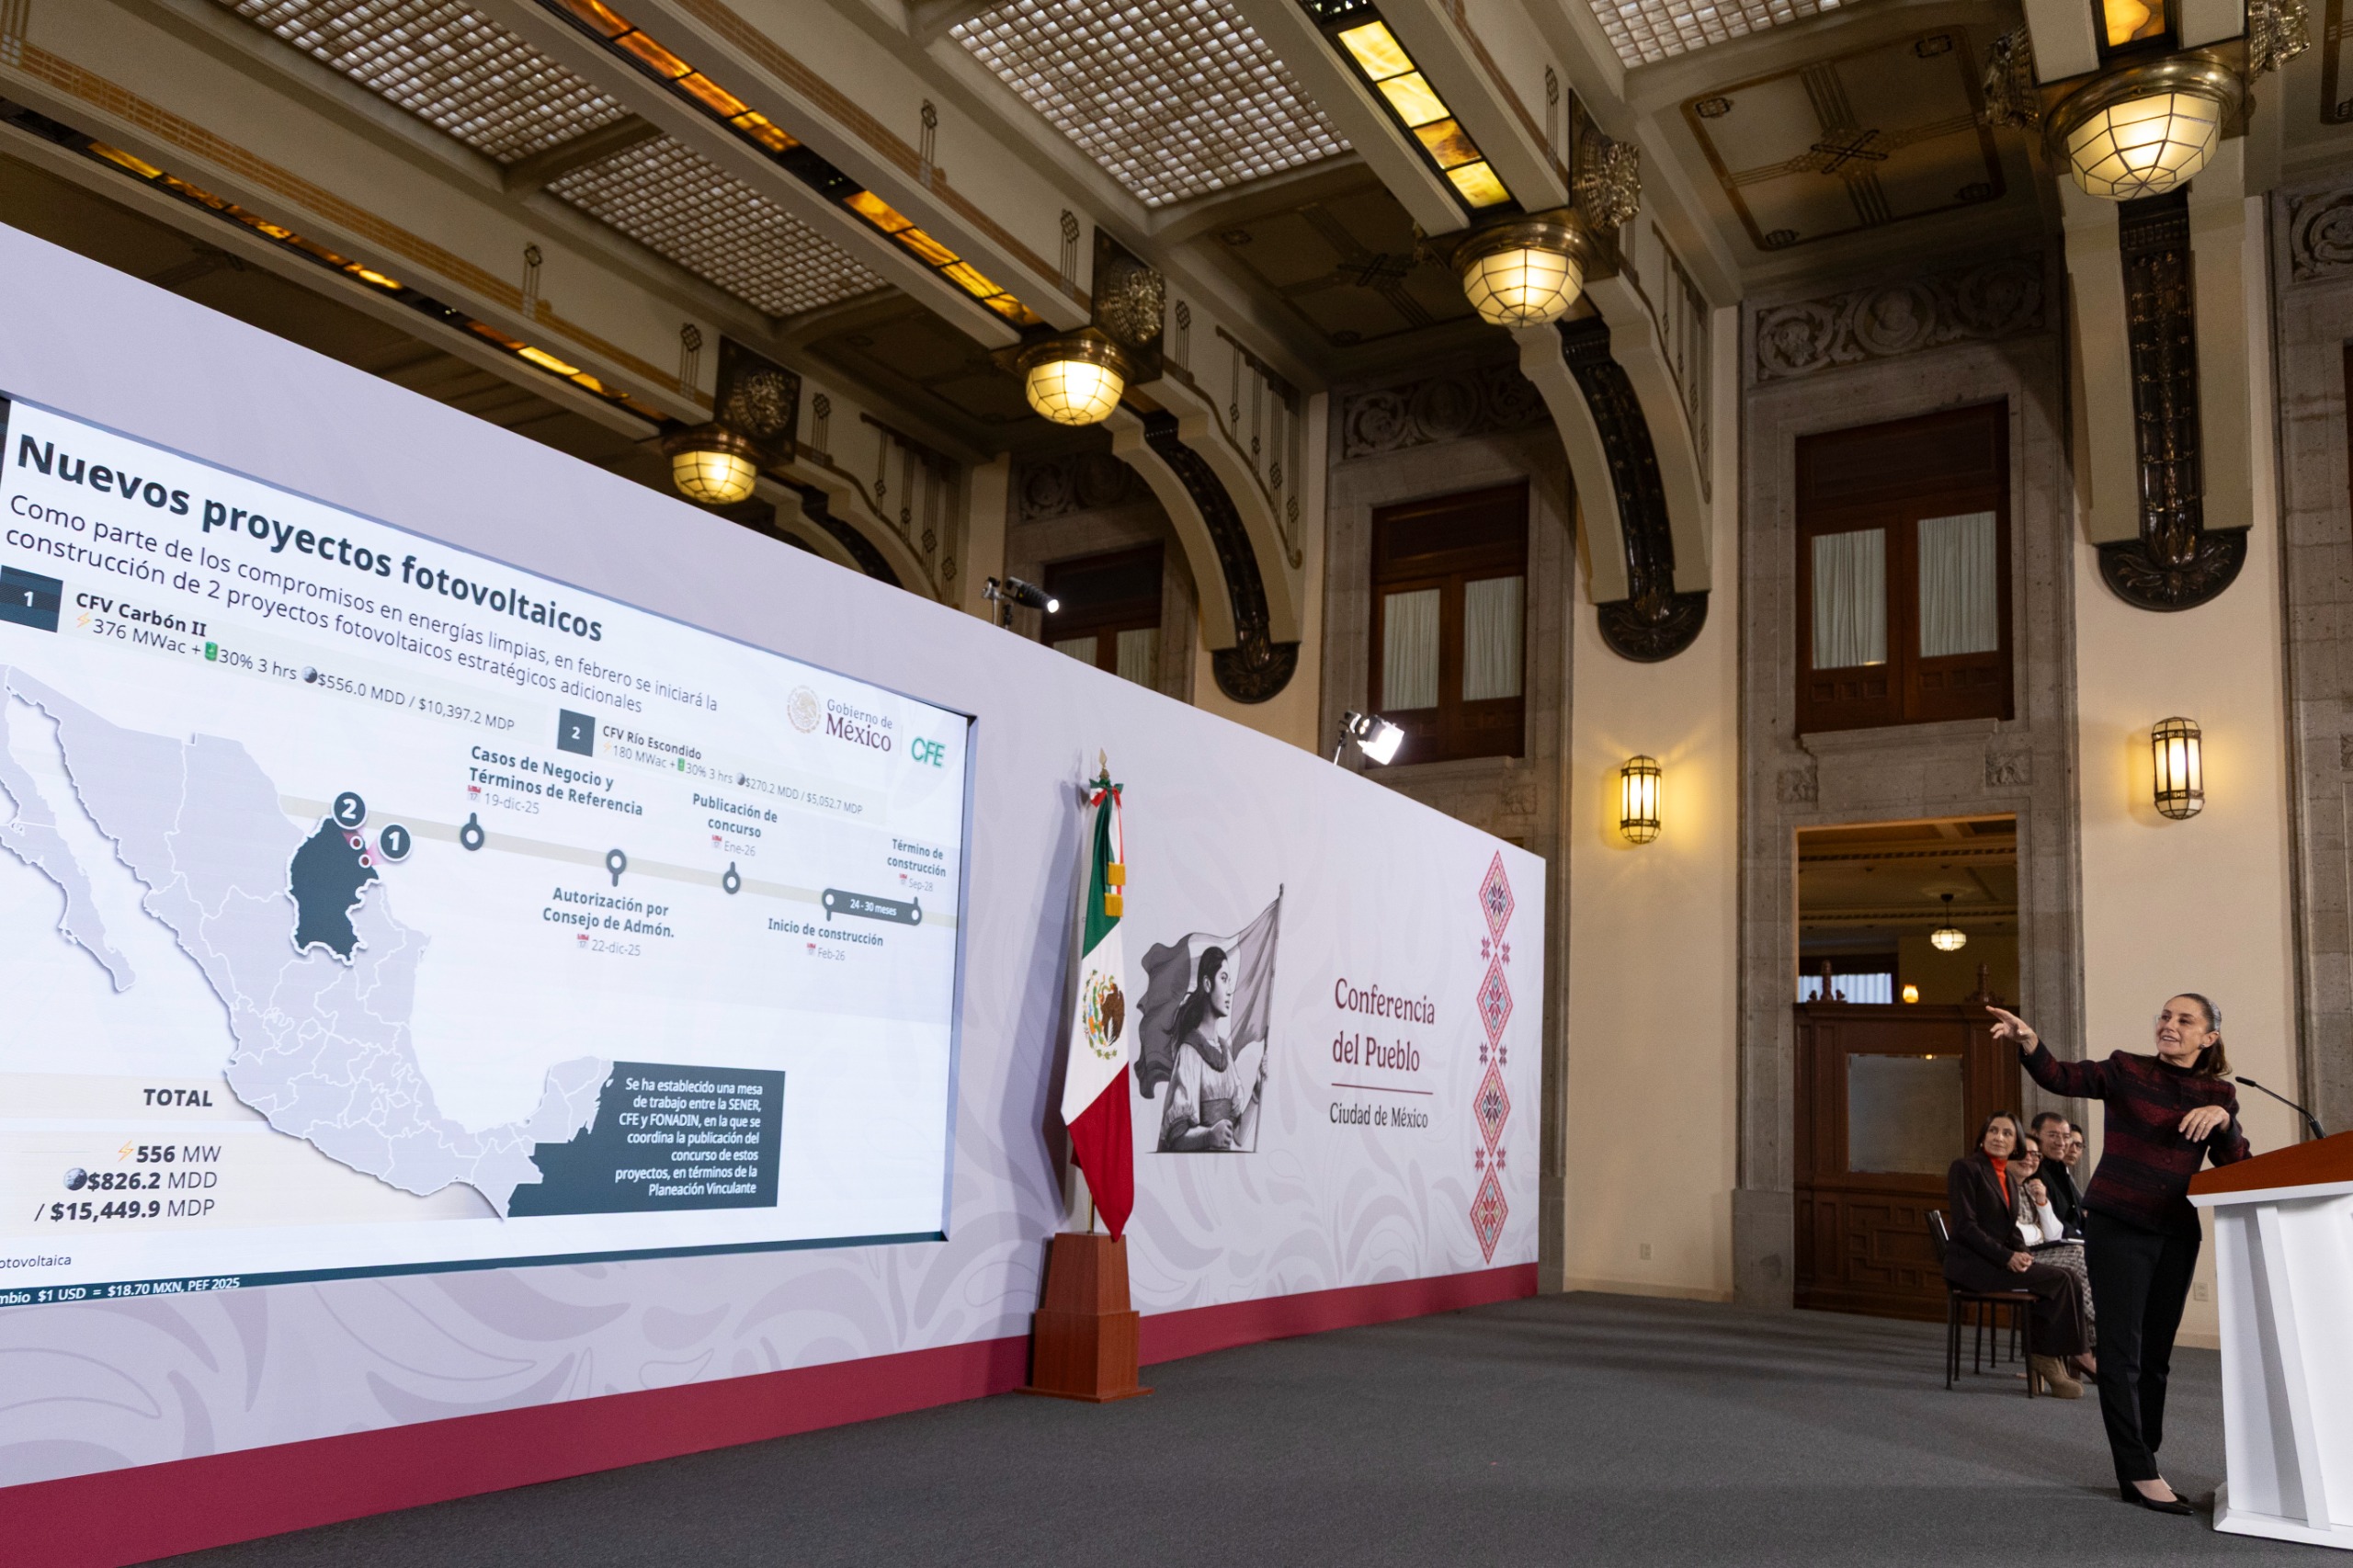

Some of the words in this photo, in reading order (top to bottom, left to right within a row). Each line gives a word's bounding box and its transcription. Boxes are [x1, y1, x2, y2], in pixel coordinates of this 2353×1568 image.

[17, 433, 190, 516] Nuevos
[202, 498, 392, 578] proyectos
[403, 555, 603, 642] fotovoltaicos
[11, 494, 85, 531] Como
[94, 519, 157, 552] parte
[165, 539, 193, 562] de
[200, 547, 231, 574] los
[238, 563, 375, 614] compromisos
[381, 604, 403, 621] en
[409, 614, 483, 645] energías
[489, 631, 550, 665] limpias,
[555, 653, 573, 670] en
[578, 658, 632, 687] febrero
[637, 676, 652, 692] se
[655, 676, 702, 708] iniciará
[707, 695, 718, 711] la
[24, 591, 33, 607] 1
[6, 528, 165, 585] construcción
[174, 571, 200, 594] de
[208, 581, 220, 598] 2
[228, 588, 329, 629] proyectos
[335, 614, 452, 662] fotovoltaicos
[458, 653, 556, 690] estratégicos
[561, 679, 642, 713] adicionales
[76, 593, 112, 614] CFV
[119, 603, 187, 632] Carbón
[191, 622, 206, 637] II
[93, 619, 127, 640] 376
[133, 629, 187, 654] MWac
[219, 650, 253, 670] 30%
[258, 658, 267, 673] 3
[273, 661, 297, 680] hrs
[318, 673, 367, 698] $556.0
[370, 686, 405, 706] MDD
[419, 697, 482, 725] $10,397.2
[485, 713, 515, 731] MDP
[827, 699, 878, 724] Gobierno
[881, 716, 892, 729] de
[572, 726, 580, 740] 2
[603, 725, 624, 741] CFV
[628, 733, 645, 745] Río
[648, 737, 701, 761] Escondido
[826, 712, 892, 752] México
[911, 737, 946, 767] CFE
[472, 745, 517, 770] Casos
[520, 756, 539, 773] de
[543, 761, 602, 788] Negocio
[606, 778, 614, 791] y
[614, 745, 632, 759] 180
[635, 752, 666, 768] MWac
[686, 763, 706, 778] 30%
[710, 768, 715, 779] 3
[719, 770, 733, 784] hrs
[745, 778, 775, 794] $270.2
[778, 785, 799, 800] MDD
[807, 792, 842, 811] $5,052.7
[844, 802, 863, 815] MDP
[470, 767, 542, 796] Términos
[546, 784, 564, 801] de
[568, 788, 643, 816] Referencia
[342, 798, 357, 820] 2
[484, 792, 540, 815] 19-dic-25
[693, 793, 762, 820] Publicación
[765, 805, 778, 823] de
[708, 817, 761, 838] concurso
[389, 831, 400, 851] 1
[724, 841, 756, 857] Ene-26
[892, 838, 930, 858] Término
[932, 846, 943, 860] de
[887, 856, 946, 878] construcción
[908, 879, 933, 892] Sep-28
[552, 887, 643, 915] Autorización
[647, 901, 669, 917] por
[849, 898, 859, 909] 24
[864, 901, 874, 912] 30
[874, 904, 897, 916] meses
[543, 907, 600, 930] Consejo
[604, 916, 620, 930] de
[623, 920, 675, 938] Admón.
[767, 918, 800, 937] Inicio
[802, 925, 815, 937] de
[818, 925, 883, 947] construcción
[591, 938, 641, 957] 22-dic-25
[818, 947, 845, 960] Feb-26
[1335, 978, 1435, 1026] Conferencia
[1332, 1031, 1359, 1065] del
[1366, 1037, 1420, 1072] Pueblo
[143, 1088, 213, 1107] TOTAL
[626, 1078, 640, 1090] Se
[642, 1078, 655, 1091] ha
[657, 1079, 715, 1093] establecido
[717, 1083, 735, 1094] una
[737, 1084, 763, 1096] mesa
[633, 1096, 647, 1108] de
[650, 1096, 687, 1111] trabajo
[689, 1097, 715, 1109] entre
[718, 1098, 726, 1109] la
[728, 1098, 761, 1112] SENER,
[620, 1113, 639, 1125] CFE
[641, 1116, 648, 1129] y
[650, 1114, 701, 1129] FONADIN,
[704, 1118, 717, 1127] en
[719, 1115, 727, 1127] la
[730, 1119, 747, 1130] que
[750, 1119, 761, 1128] se
[1330, 1103, 1370, 1126] Ciudad
[1374, 1105, 1389, 1126] de
[1392, 1107, 1428, 1129] México
[627, 1131, 674, 1143] coordina
[676, 1131, 685, 1143] la
[688, 1131, 743, 1146] publicación
[745, 1132, 759, 1143] del
[136, 1145, 176, 1163] 556
[183, 1145, 222, 1163] MW
[671, 1151, 717, 1161] concurso
[719, 1149, 732, 1160] de
[733, 1151, 758, 1161] estos
[87, 1172, 160, 1192] $826.2
[167, 1171, 218, 1189] MDD
[615, 1168, 670, 1183] proyectos,
[673, 1169, 686, 1178] en
[688, 1165, 733, 1178] términos
[734, 1165, 746, 1177] de
[749, 1165, 757, 1177] la
[649, 1183, 704, 1196] Planeación
[706, 1182, 756, 1194] Vinculante
[51, 1200, 160, 1222] $15,449.9
[167, 1199, 215, 1217] MDP
[38, 1290, 52, 1302] $1
[58, 1288, 86, 1301] USD
[108, 1283, 150, 1298] $18.70
[153, 1281, 184, 1295] MXN,
[188, 1279, 210, 1292] PEF
[212, 1277, 240, 1290] 2025
